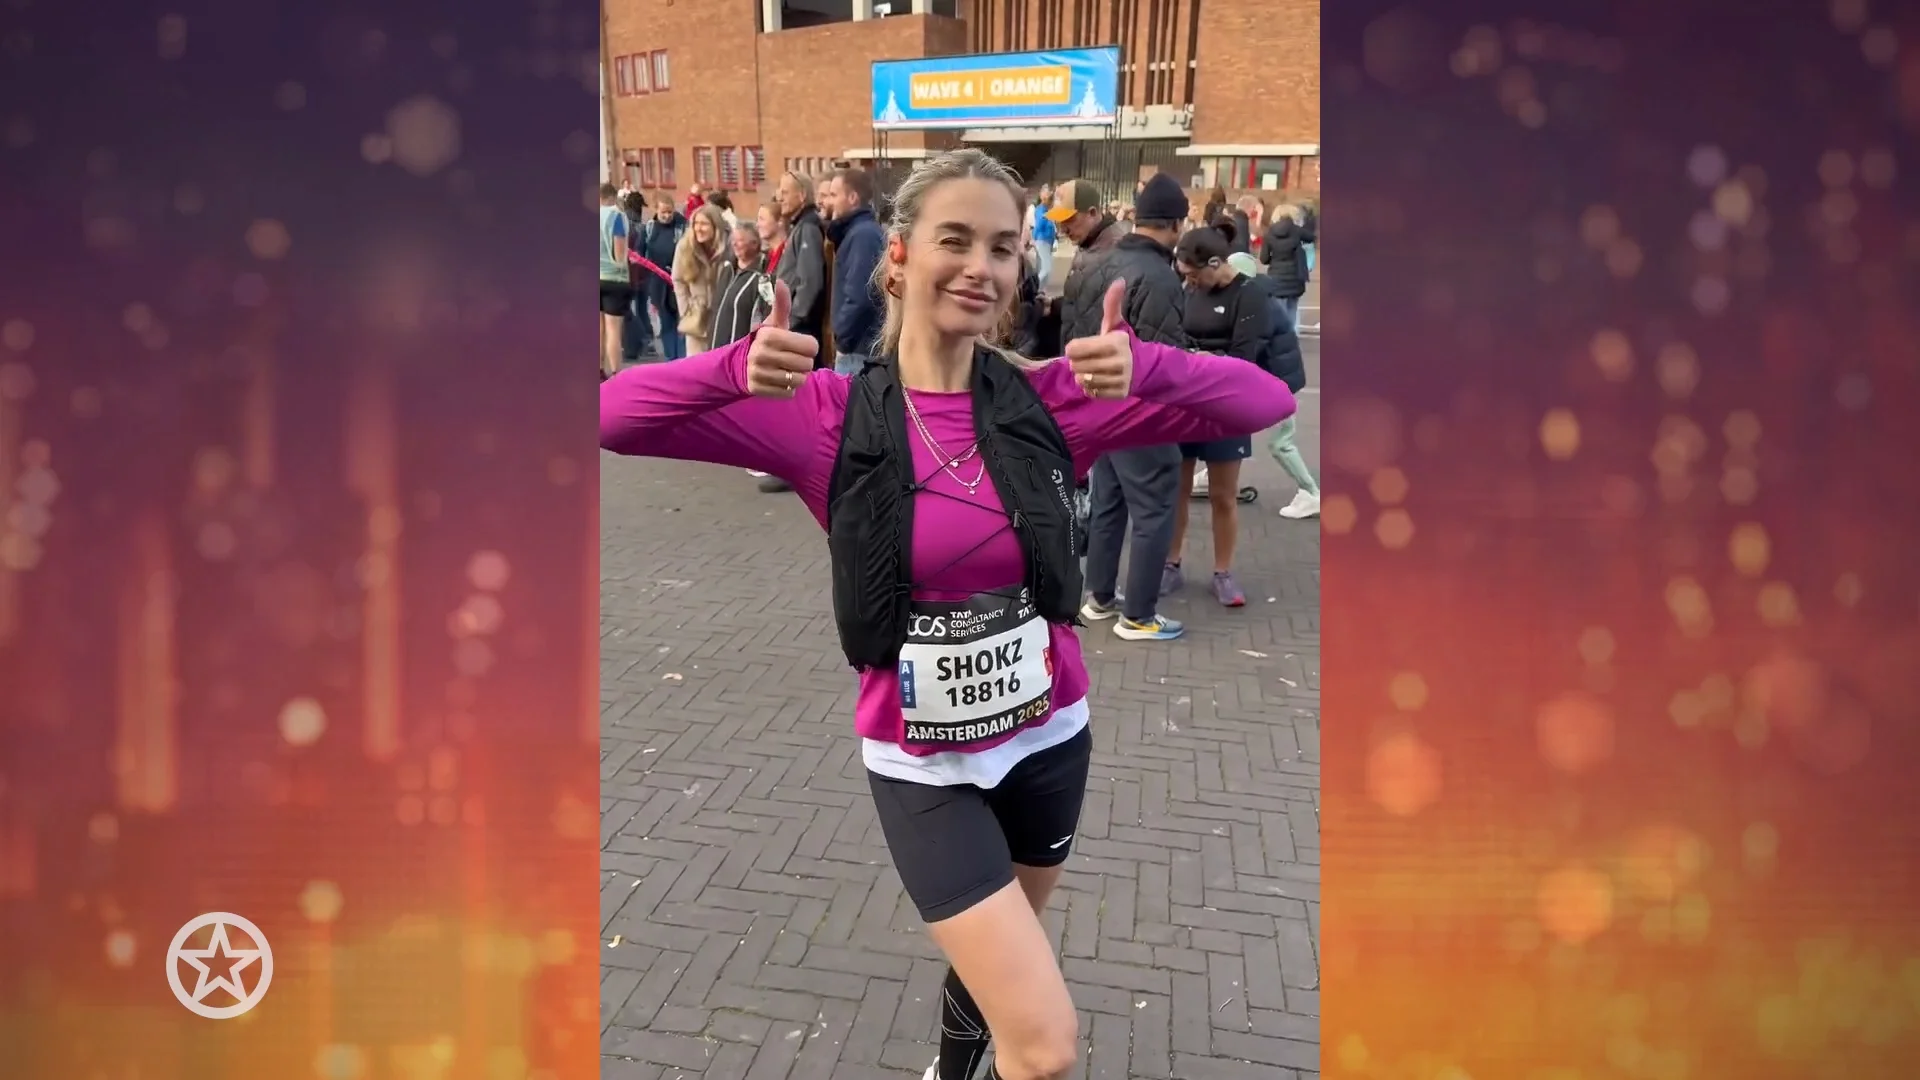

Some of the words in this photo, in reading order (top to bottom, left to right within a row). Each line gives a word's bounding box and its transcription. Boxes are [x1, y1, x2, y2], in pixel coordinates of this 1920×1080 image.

[914, 81, 960, 99] WAVE
[963, 80, 974, 98] 4
[990, 76, 1064, 97] ORANGE
[950, 609, 972, 619] TATA
[950, 608, 1005, 629] CONSULTANCY
[950, 623, 987, 638] SERVICES
[901, 662, 910, 674] A
[936, 637, 1023, 682] SHOKZ
[945, 671, 1021, 707] 18816
[907, 714, 1014, 741] AMSTERDAM
[1017, 694, 1050, 717] 2025
